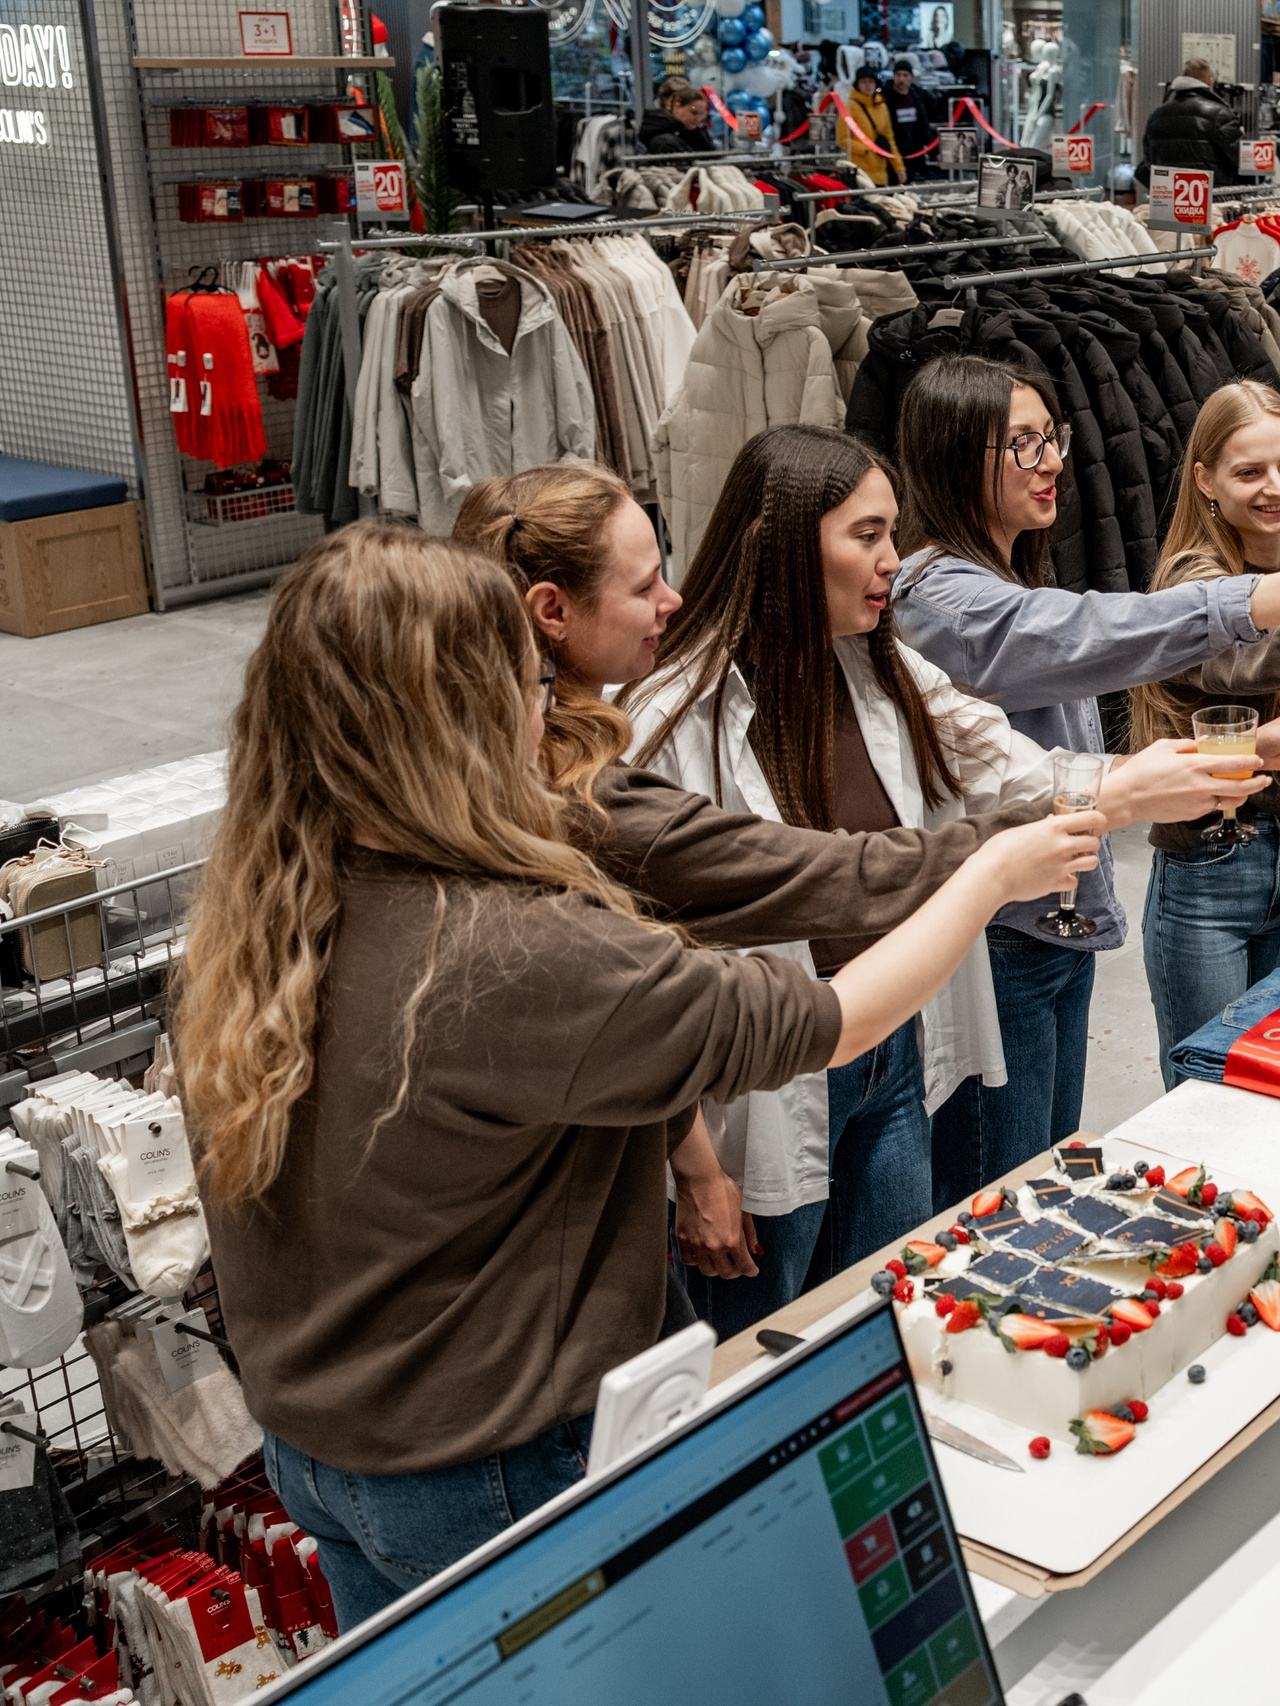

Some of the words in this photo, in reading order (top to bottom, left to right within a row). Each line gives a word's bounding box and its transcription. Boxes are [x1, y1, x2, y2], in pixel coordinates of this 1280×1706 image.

[0, 24, 73, 89] DAY!
[0, 108, 48, 145] OLIN'S
[1174, 179, 1209, 207] 20%
[1174, 206, 1205, 217] СКИДКА
[140, 1147, 171, 1161] COLIN'S
[0, 1187, 26, 1201] OLIN'S
[171, 1340, 201, 1358] COLIN'S
[0, 1444, 21, 1456] LIN'S
